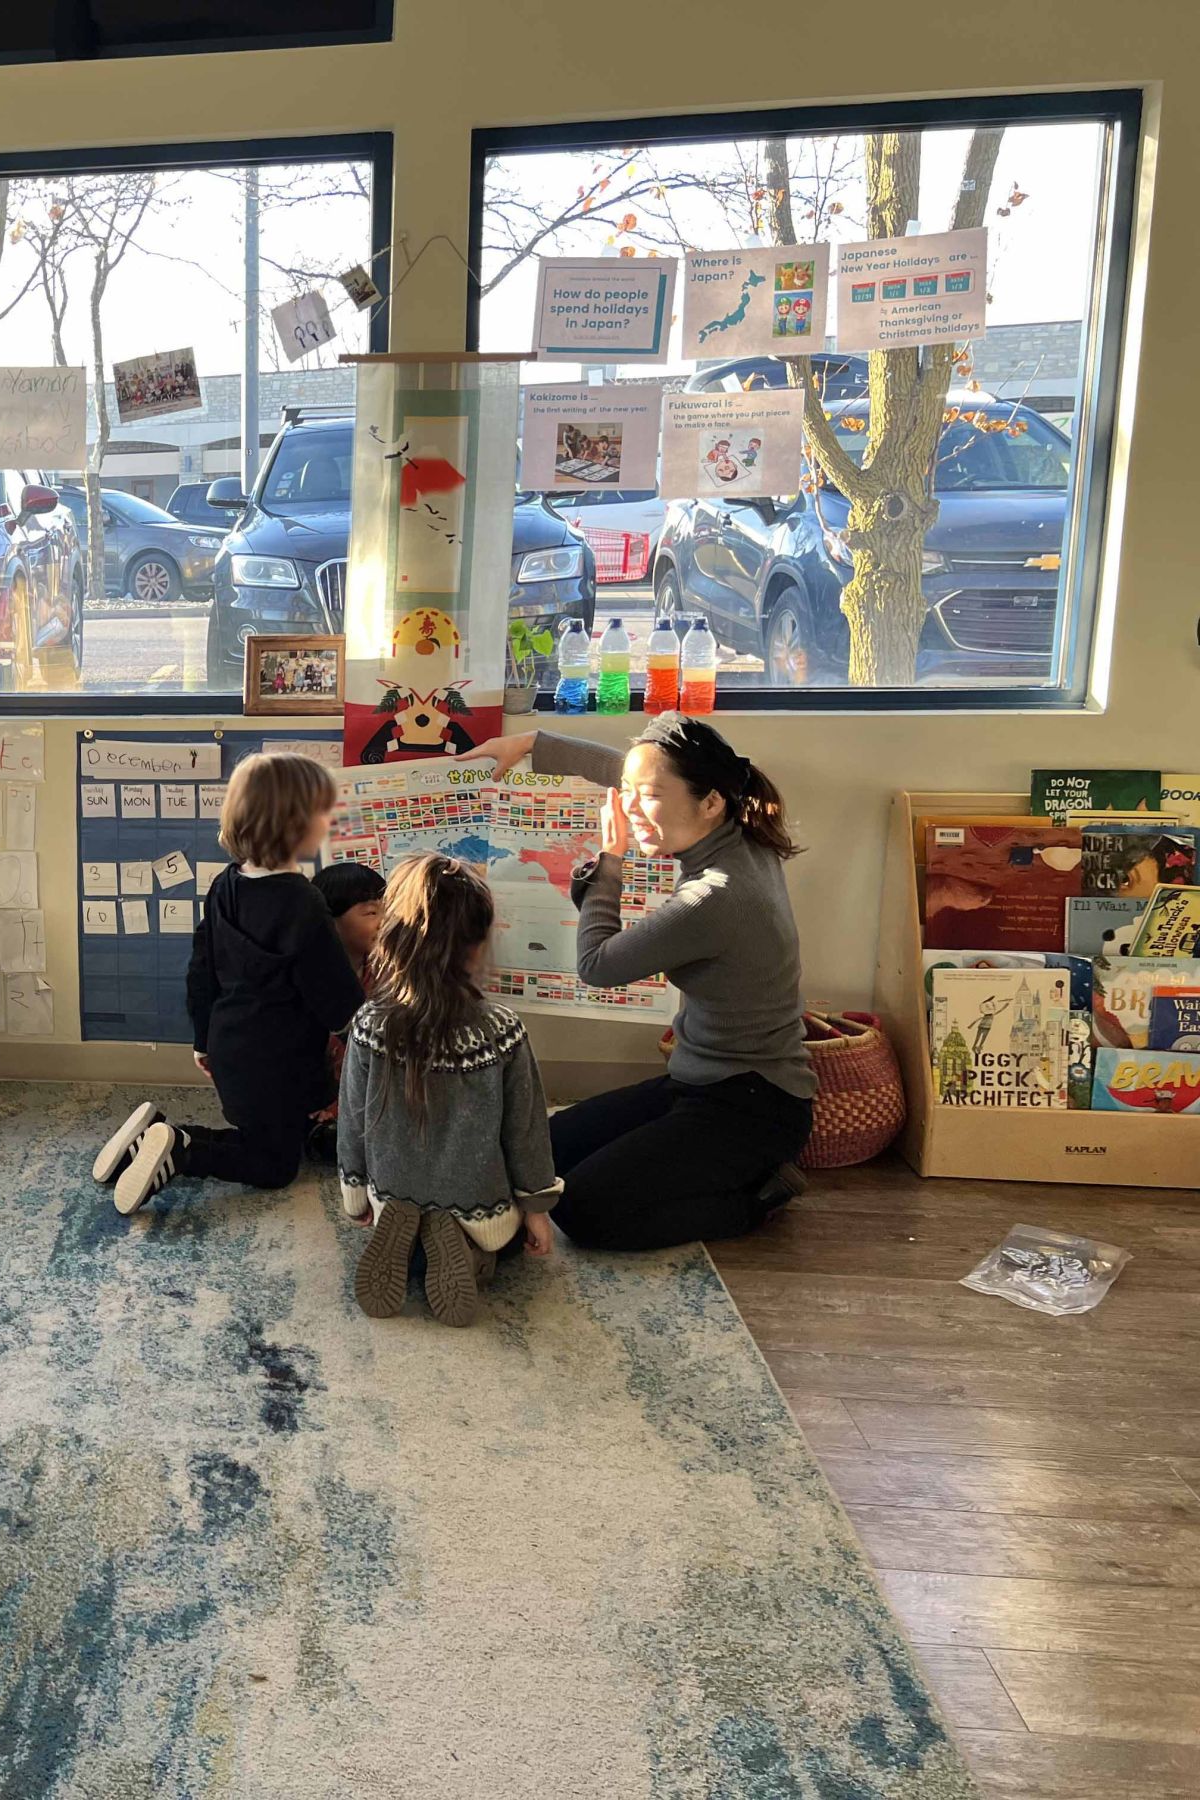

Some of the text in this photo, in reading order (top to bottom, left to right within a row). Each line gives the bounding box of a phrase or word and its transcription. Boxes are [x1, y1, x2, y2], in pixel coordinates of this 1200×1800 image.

[841, 247, 897, 261] Japanese
[691, 256, 742, 268] Where is
[841, 264, 863, 273] New
[866, 261, 890, 271] Year
[893, 256, 940, 268] Holidays
[949, 253, 967, 261] are
[690, 271, 734, 284] Japan?
[553, 289, 648, 302] How do people
[550, 304, 649, 317] spend holidays
[892, 302, 941, 315] American
[566, 318, 630, 331] in Japan?
[879, 313, 962, 328] Thanksgiving or
[879, 322, 980, 339] Christmas holidays
[530, 392, 577, 401] Kakizome
[580, 392, 588, 400] is
[562, 406, 587, 414] writing
[669, 400, 722, 410] Fukuwarai
[725, 399, 733, 407] is
[711, 411, 733, 419] where
[736, 411, 750, 420] you
[752, 410, 764, 418] put
[87, 748, 182, 773] December
[1051, 777, 1091, 789] DO NOT
[1046, 789, 1088, 797] LET YOUR
[87, 796, 108, 806] SUN
[124, 797, 150, 807] MON
[167, 797, 188, 807] TUE
[1044, 797, 1093, 811] DRAGON
[1049, 811, 1066, 820] SPR
[1082, 836, 1123, 852] NDER
[165, 855, 178, 874] 5
[89, 865, 100, 881] 3
[126, 868, 144, 886] 4
[1086, 873, 1116, 889] OCK
[163, 903, 178, 919] 12
[1073, 900, 1091, 911] I'll
[86, 906, 107, 923] 10
[1157, 898, 1189, 933] Truck's
[1178, 1010, 1191, 1021] Is
[974, 1052, 1024, 1067] IGGY
[942, 1090, 1055, 1107] ARCHITECT
[1065, 1146, 1107, 1154] KAPLAN
